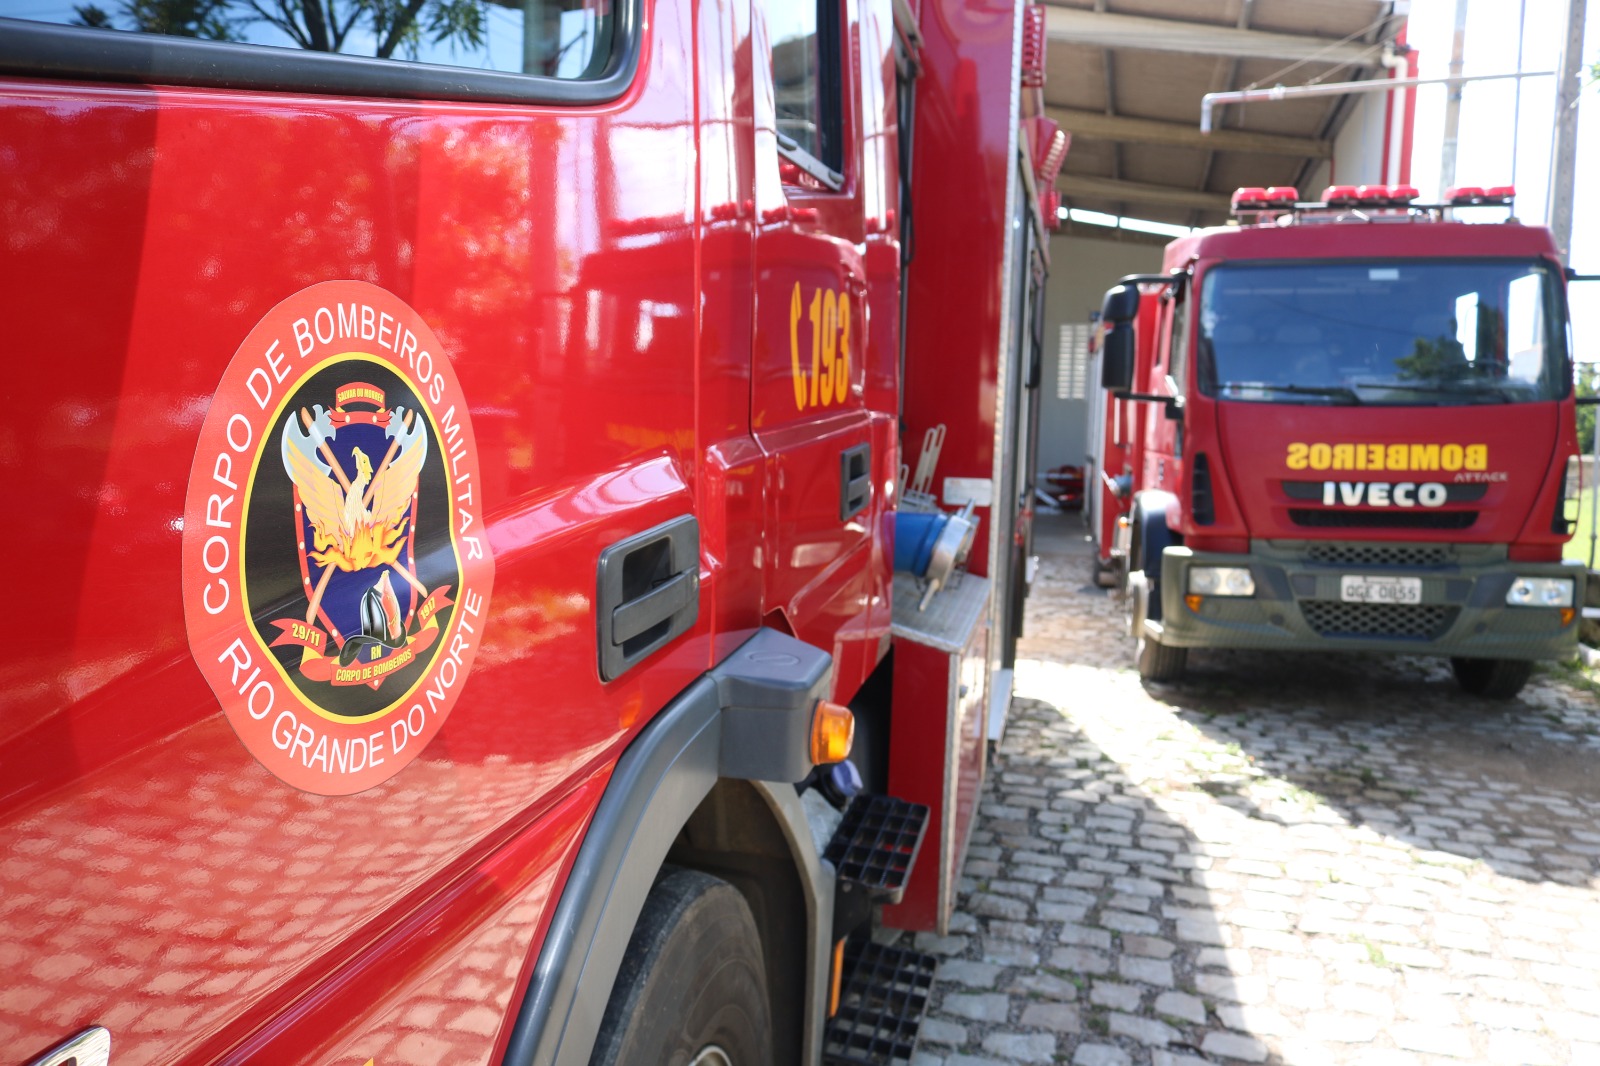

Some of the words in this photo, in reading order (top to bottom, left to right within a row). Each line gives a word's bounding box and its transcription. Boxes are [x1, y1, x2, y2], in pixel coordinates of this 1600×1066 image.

[809, 287, 849, 407] 193
[202, 413, 252, 615] CORPO
[245, 339, 292, 410] DE
[292, 302, 445, 405] BOMBEIROS
[441, 405, 483, 561] MILITAR
[1322, 481, 1448, 507] IVECO
[420, 597, 436, 621] 1917
[291, 623, 321, 646] 29/11
[335, 669, 361, 682] CORPO
[362, 666, 372, 680] DE
[373, 648, 412, 677] BOMBEIROS
[370, 644, 382, 660] RN
[218, 637, 275, 720] RIO
[271, 710, 384, 774] GRANDE
[390, 703, 425, 755] DO
[426, 588, 483, 714] NORTE
